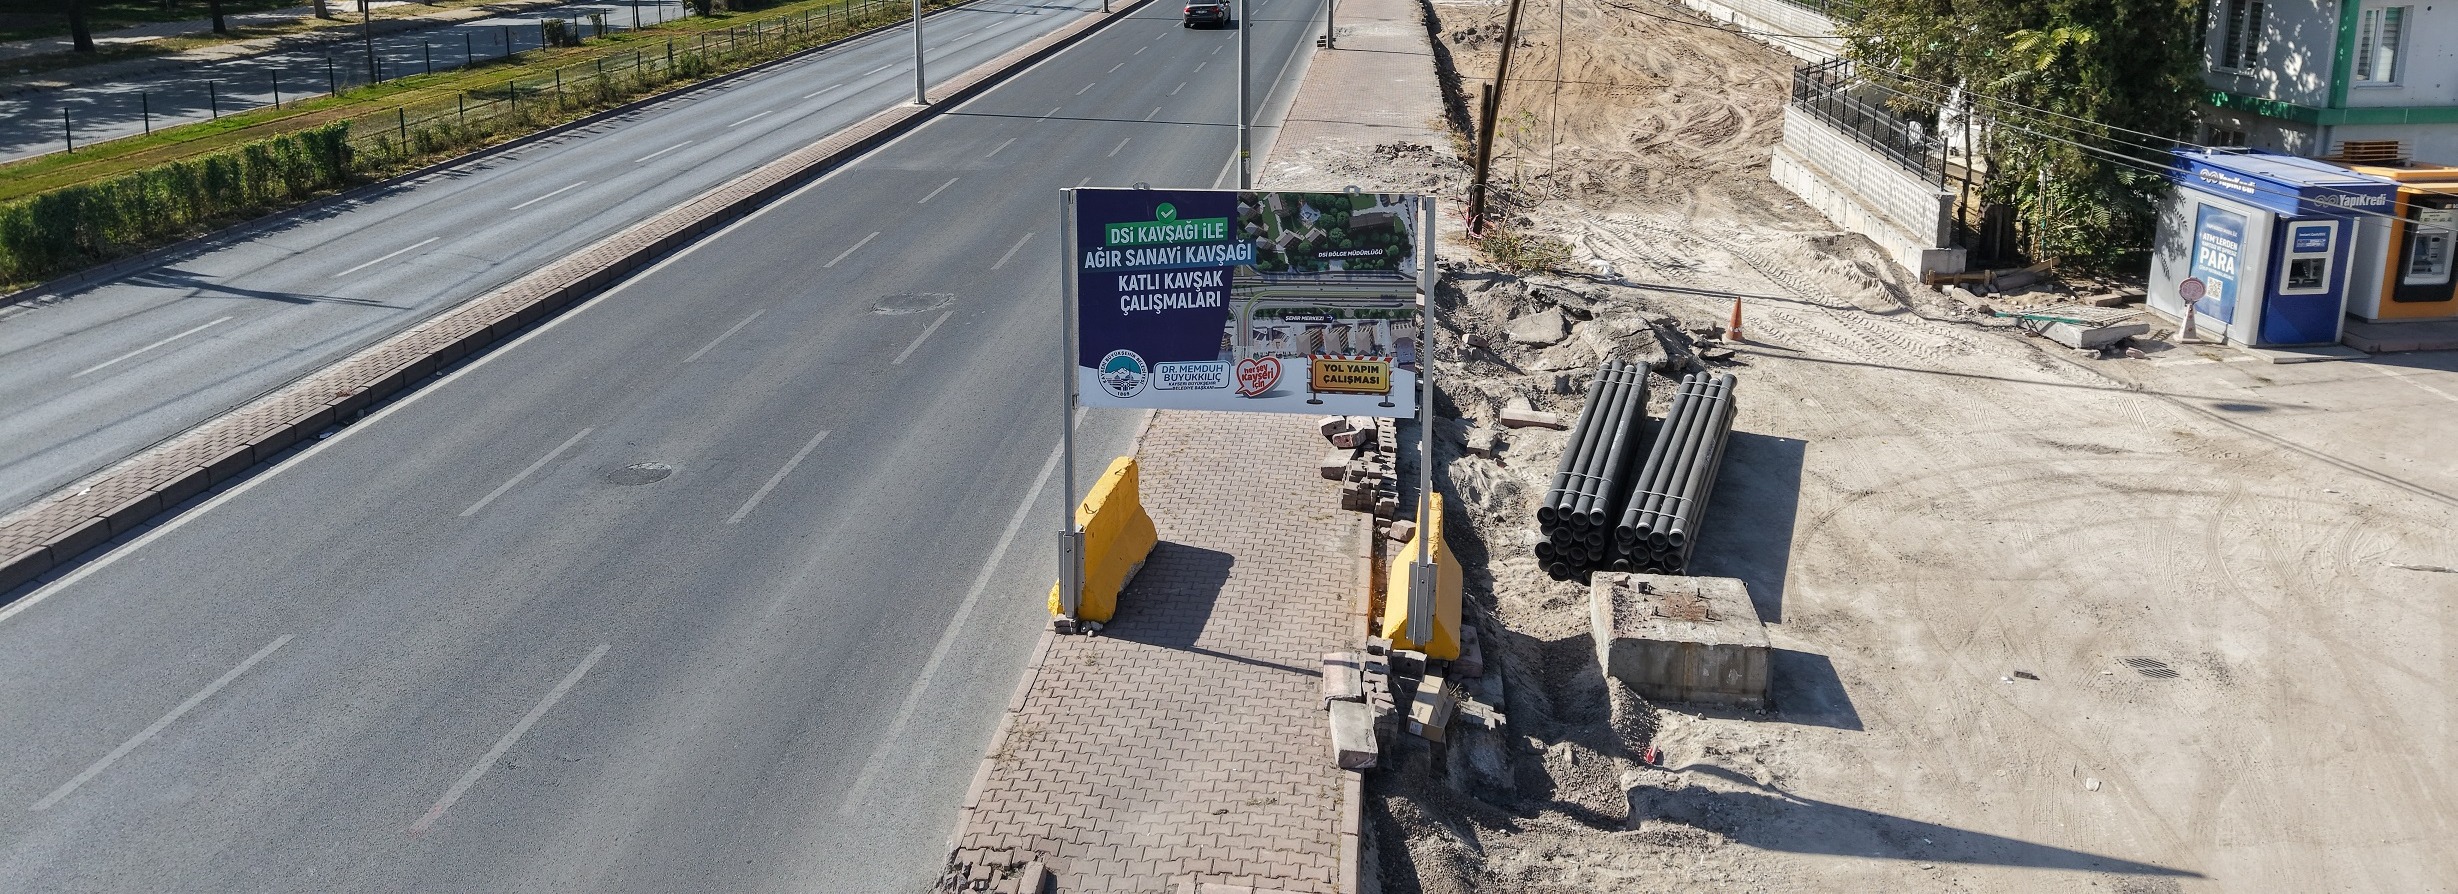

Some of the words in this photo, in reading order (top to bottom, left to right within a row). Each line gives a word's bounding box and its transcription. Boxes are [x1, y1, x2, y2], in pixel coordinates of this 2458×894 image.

[1138, 221, 1198, 244] KAVŞAĞI
[1085, 247, 1122, 269] AĞIR
[1186, 239, 1252, 266] KAVŞAĞI
[1328, 250, 1347, 258] BÖLGE
[2199, 246, 2235, 275] PARA
[1118, 273, 1160, 292] KATLI
[1164, 270, 1224, 292] KAVŞAK
[1120, 290, 1221, 316] ÇALIŞMALARI
[1161, 365, 1177, 374] DR.
[1179, 364, 1224, 373] MEMDUH
[1323, 364, 1345, 373] YOL
[1348, 364, 1379, 374] YAPIM
[1163, 372, 1222, 383] BÜYÜKKILIÇ
[1323, 374, 1380, 385] ÇALIŞMASI
